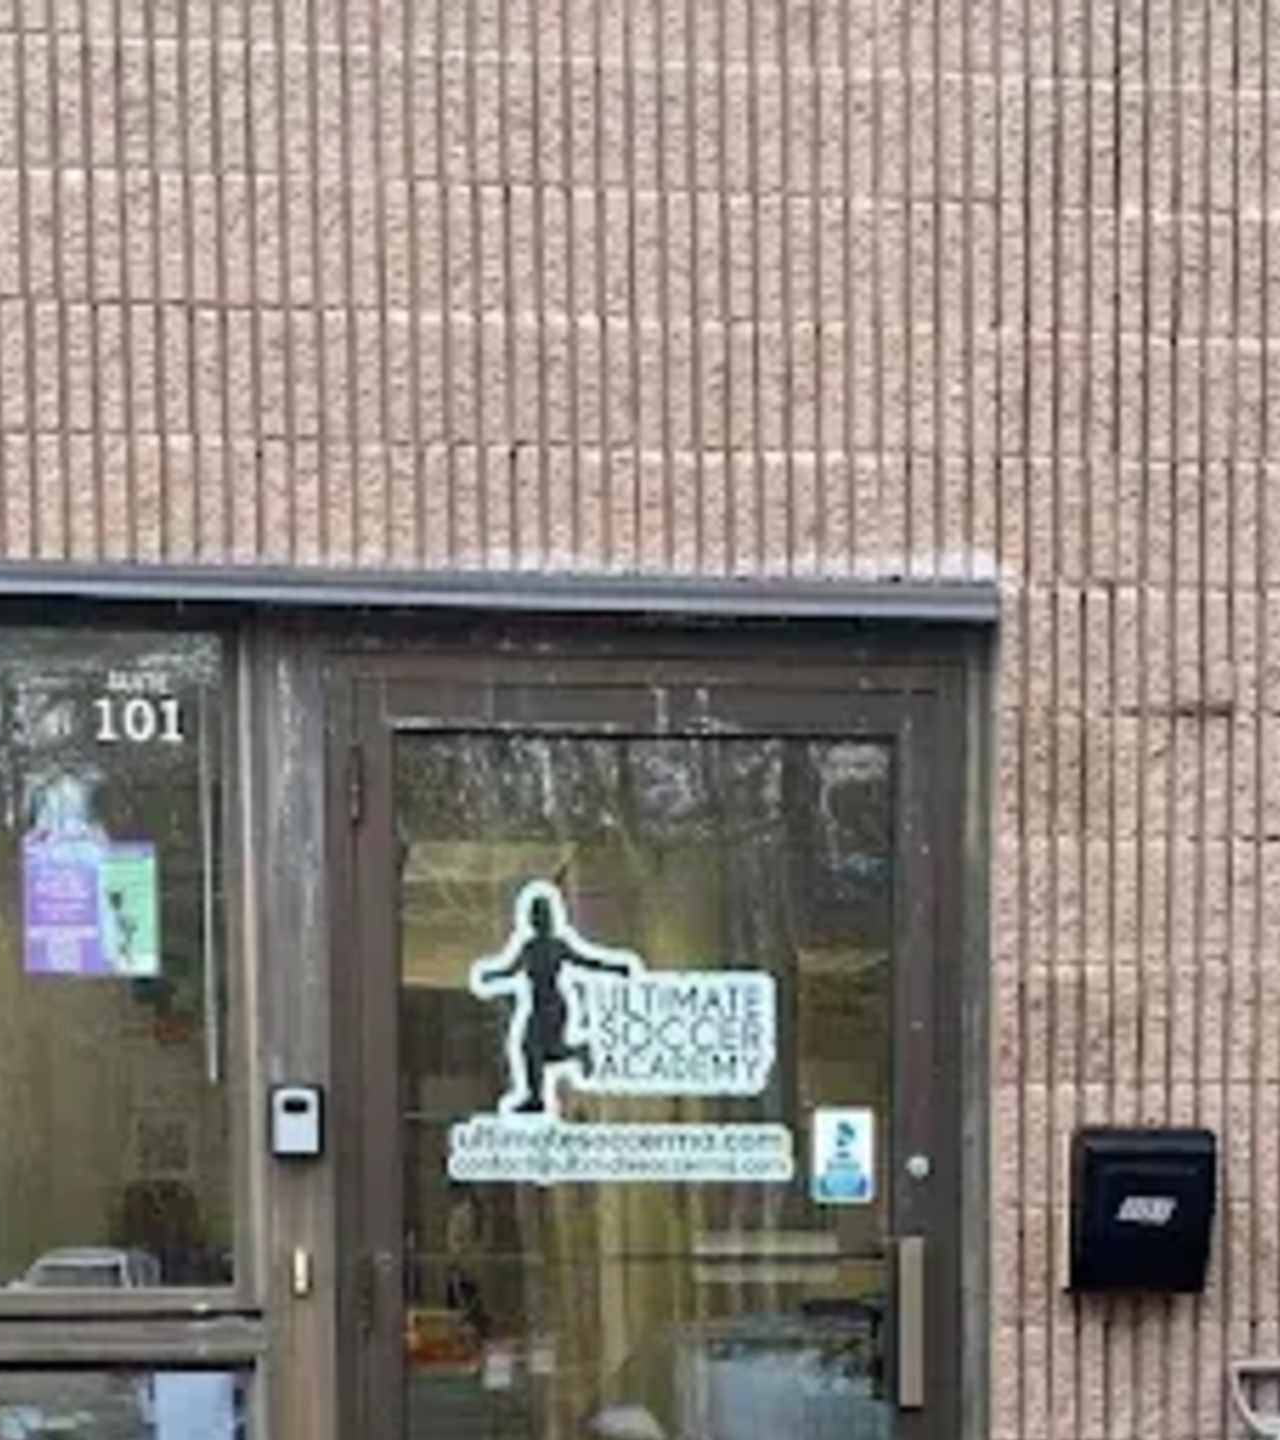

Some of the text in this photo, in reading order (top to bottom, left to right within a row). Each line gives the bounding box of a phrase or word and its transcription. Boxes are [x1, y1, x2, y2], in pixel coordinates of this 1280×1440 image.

[93, 698, 184, 742] 101
[597, 980, 761, 1018] ULTIMATE
[598, 1014, 764, 1052] SOCCER
[599, 1052, 760, 1082] ACADEMY
